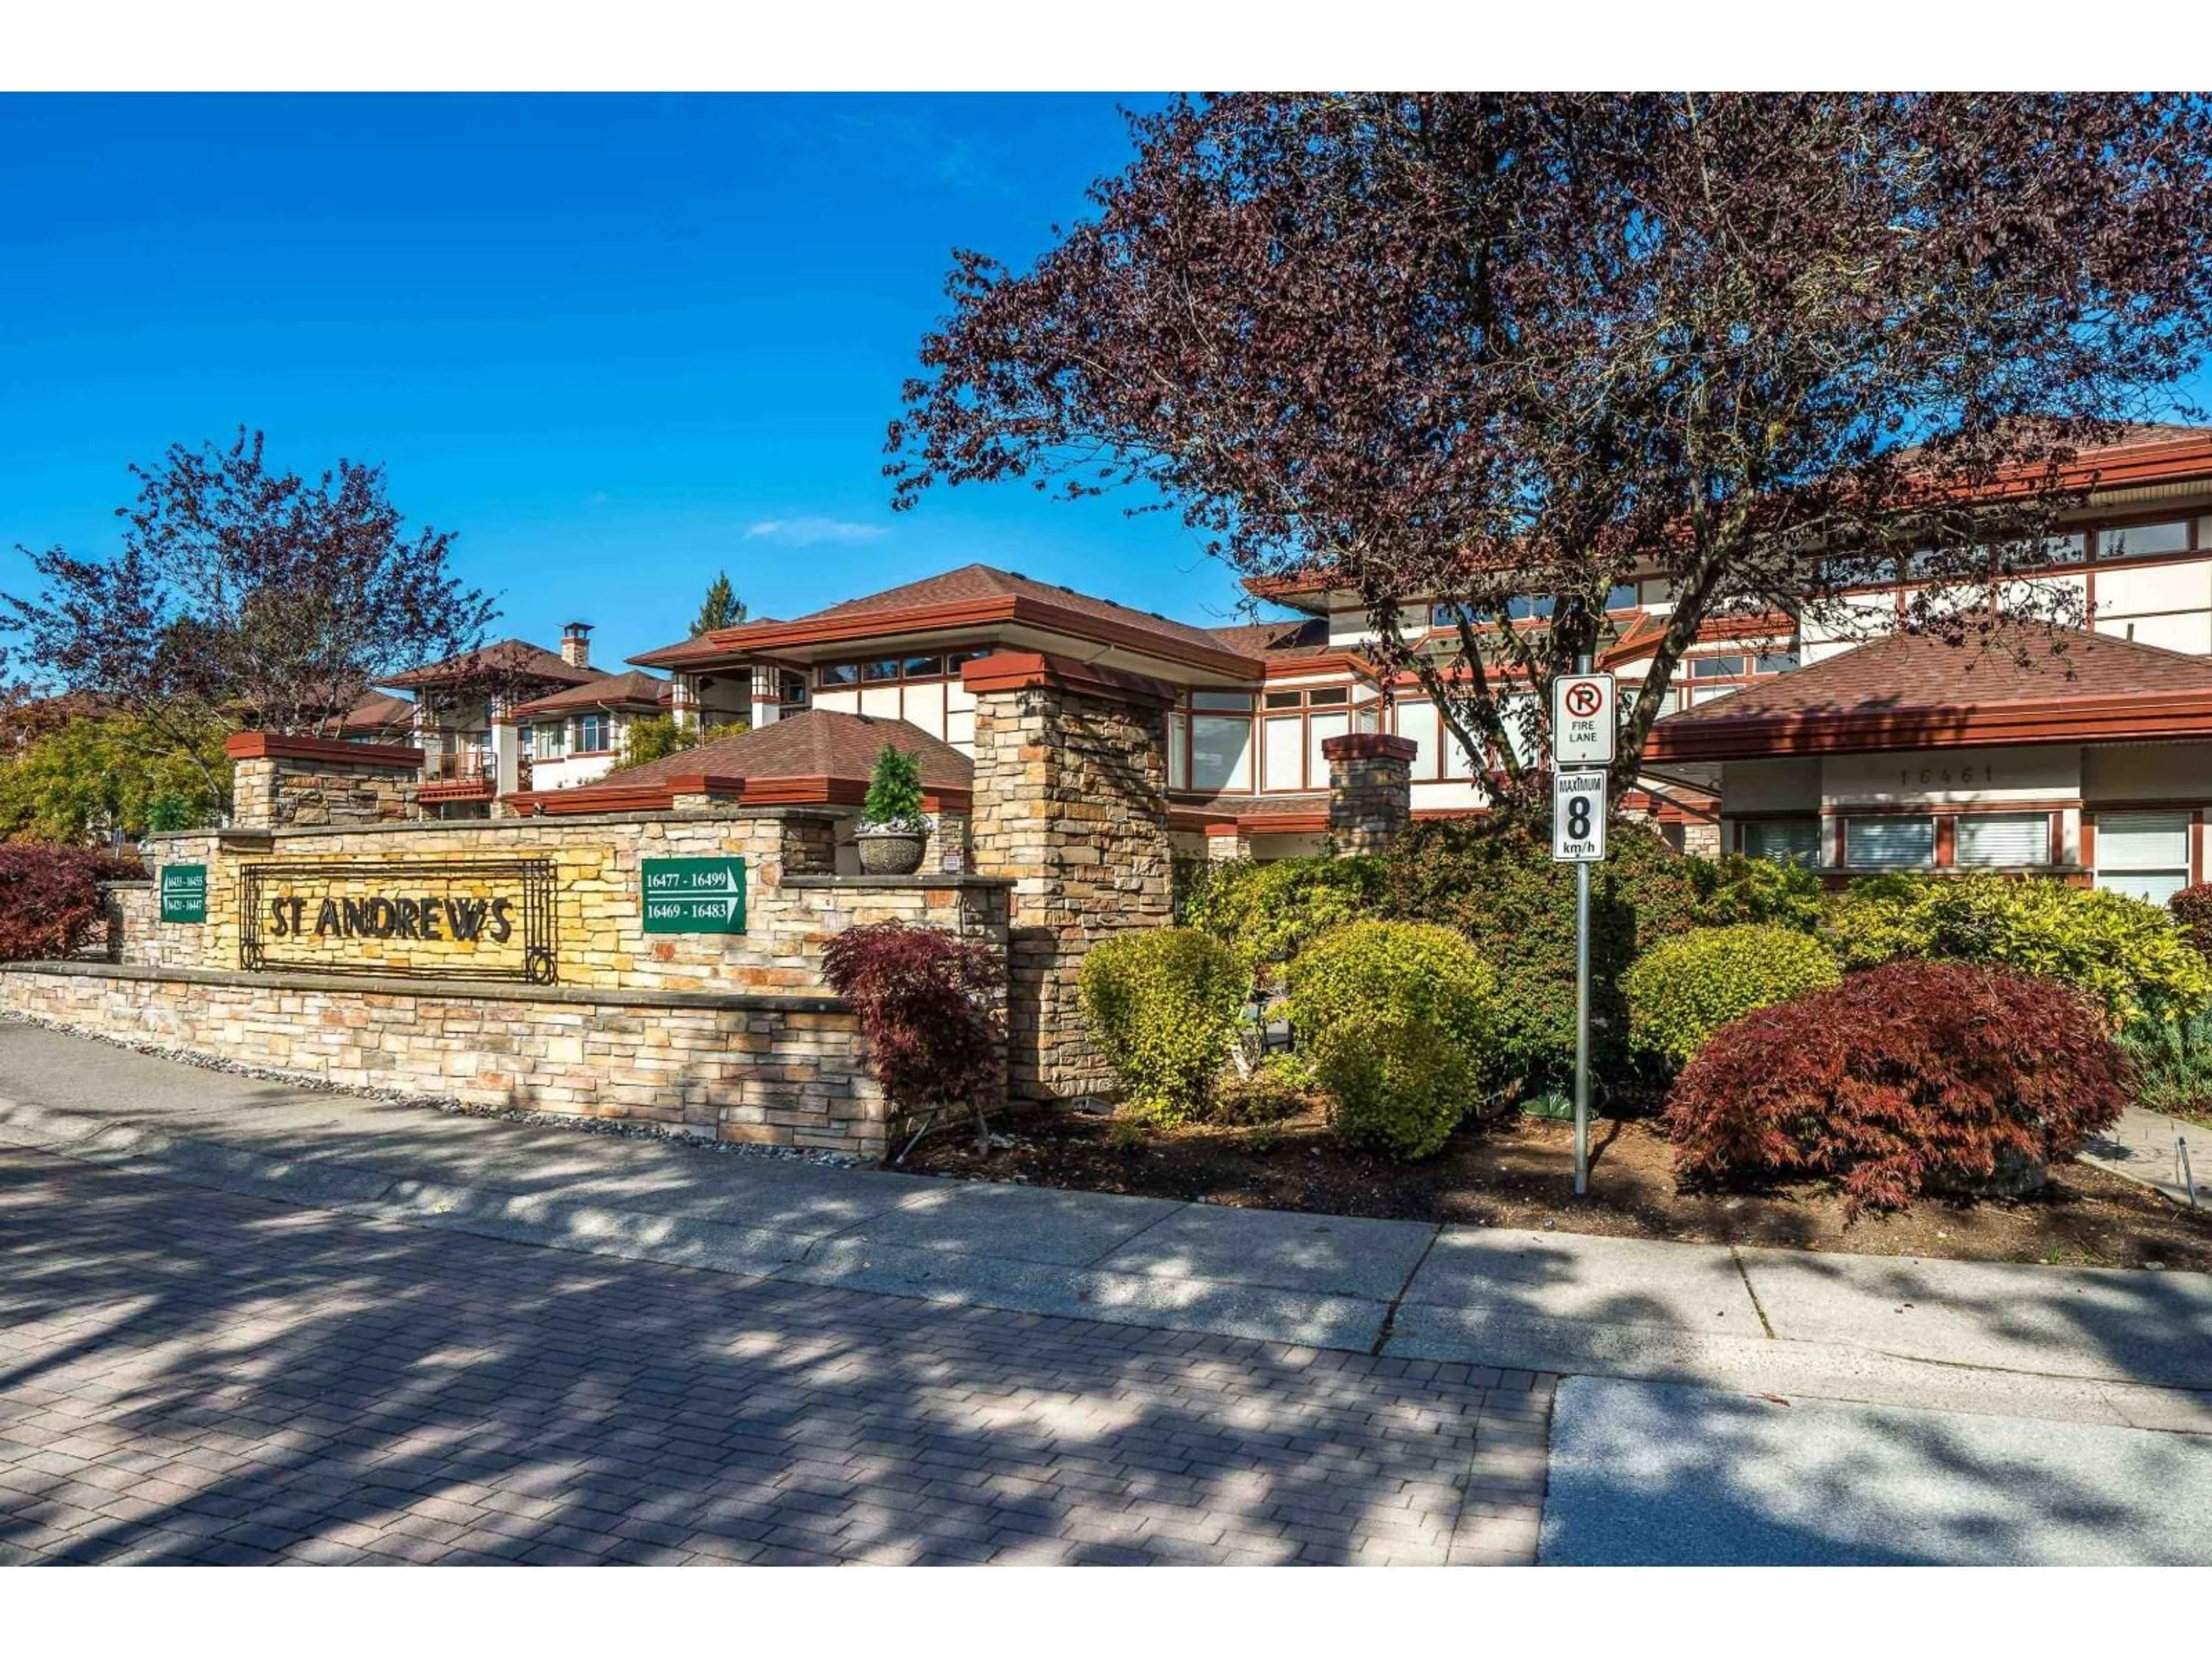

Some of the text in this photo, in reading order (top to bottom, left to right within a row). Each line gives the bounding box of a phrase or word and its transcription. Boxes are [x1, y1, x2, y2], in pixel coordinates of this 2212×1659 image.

[1572, 721, 1594, 730] FIRE
[1569, 733, 1597, 742] LANE
[1900, 766, 1991, 786] 16461
[1559, 778, 1600, 793] MAXIMUM
[1568, 796, 1590, 839] 8
[1563, 840, 1594, 854] km/h
[647, 874, 680, 887] 16477
[692, 872, 726, 887] 16499
[647, 904, 680, 918] 16469
[692, 904, 726, 918] 16483
[270, 896, 512, 943] ST ANDREWS
